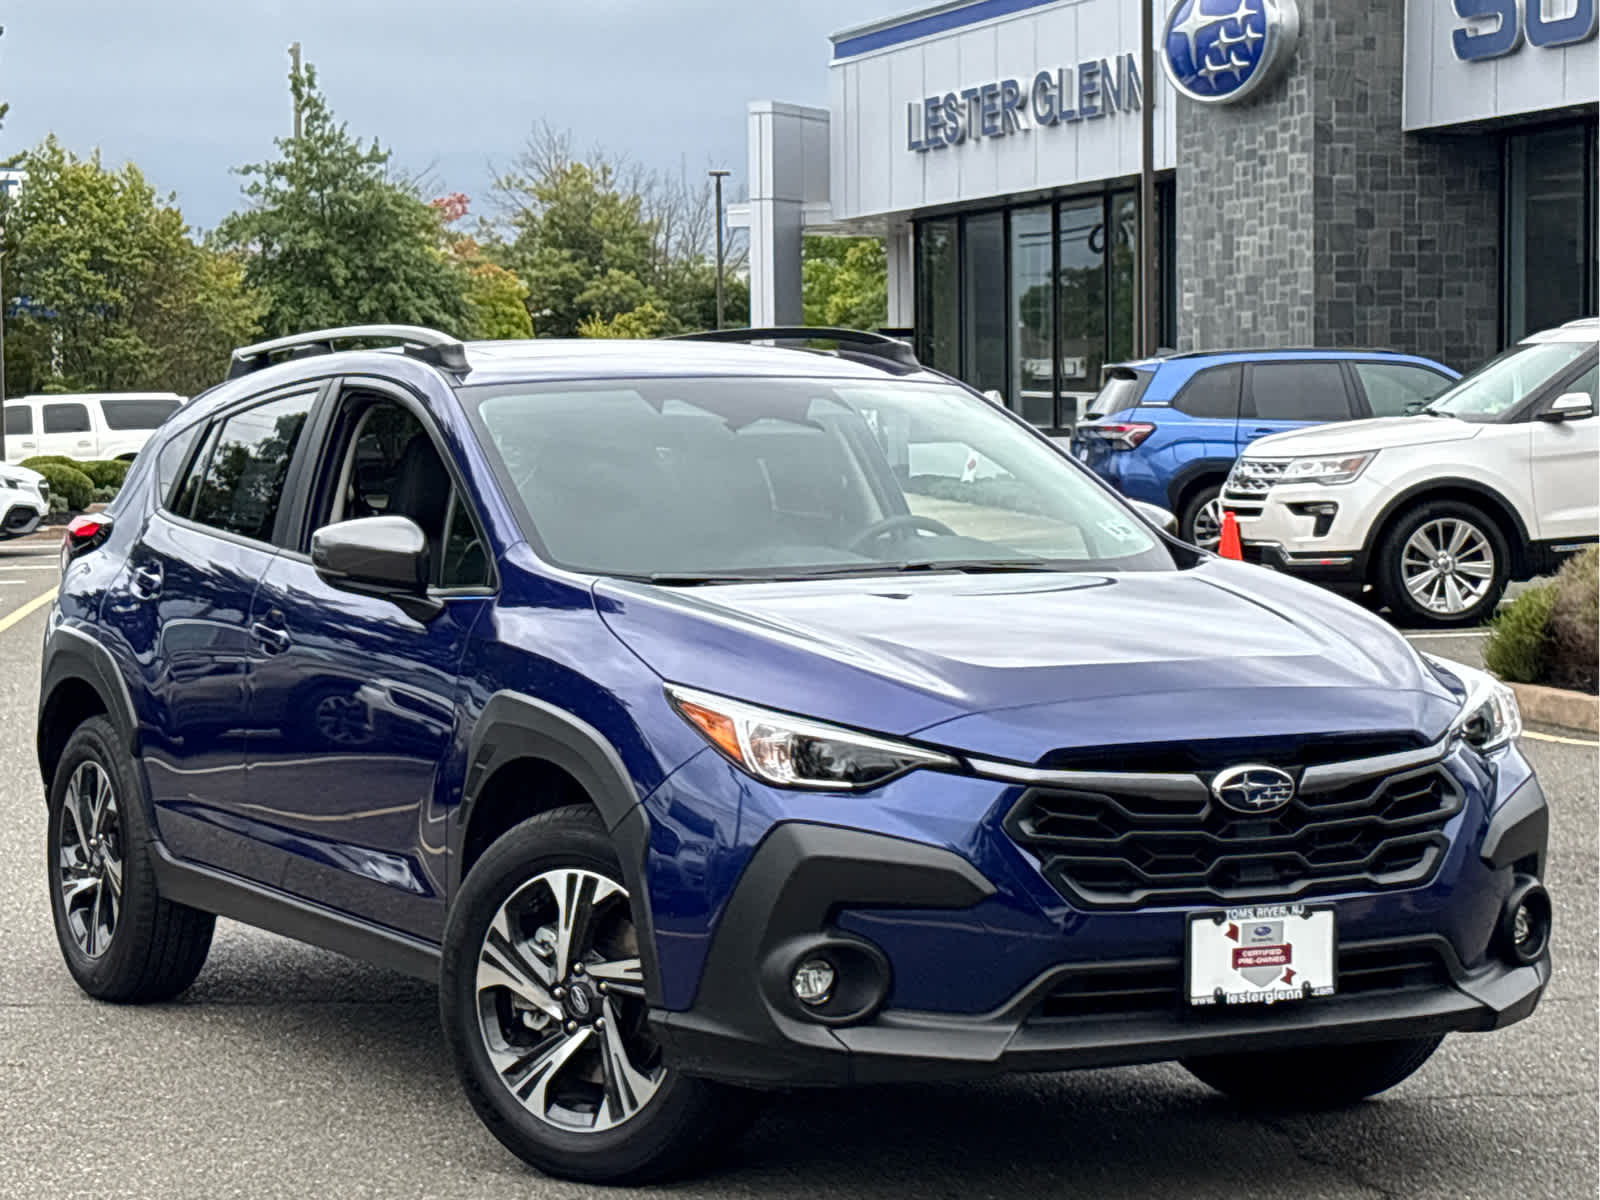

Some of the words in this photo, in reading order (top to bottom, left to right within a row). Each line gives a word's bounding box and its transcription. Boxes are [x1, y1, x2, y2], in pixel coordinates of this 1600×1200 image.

[907, 79, 1026, 151] LESTER
[1226, 908, 1254, 920] TOMS
[1291, 903, 1305, 915] NJ
[1237, 955, 1286, 964] PRE-OWNED
[1242, 949, 1283, 957] CERTIFIED
[1226, 989, 1303, 1004] lesterglenn
